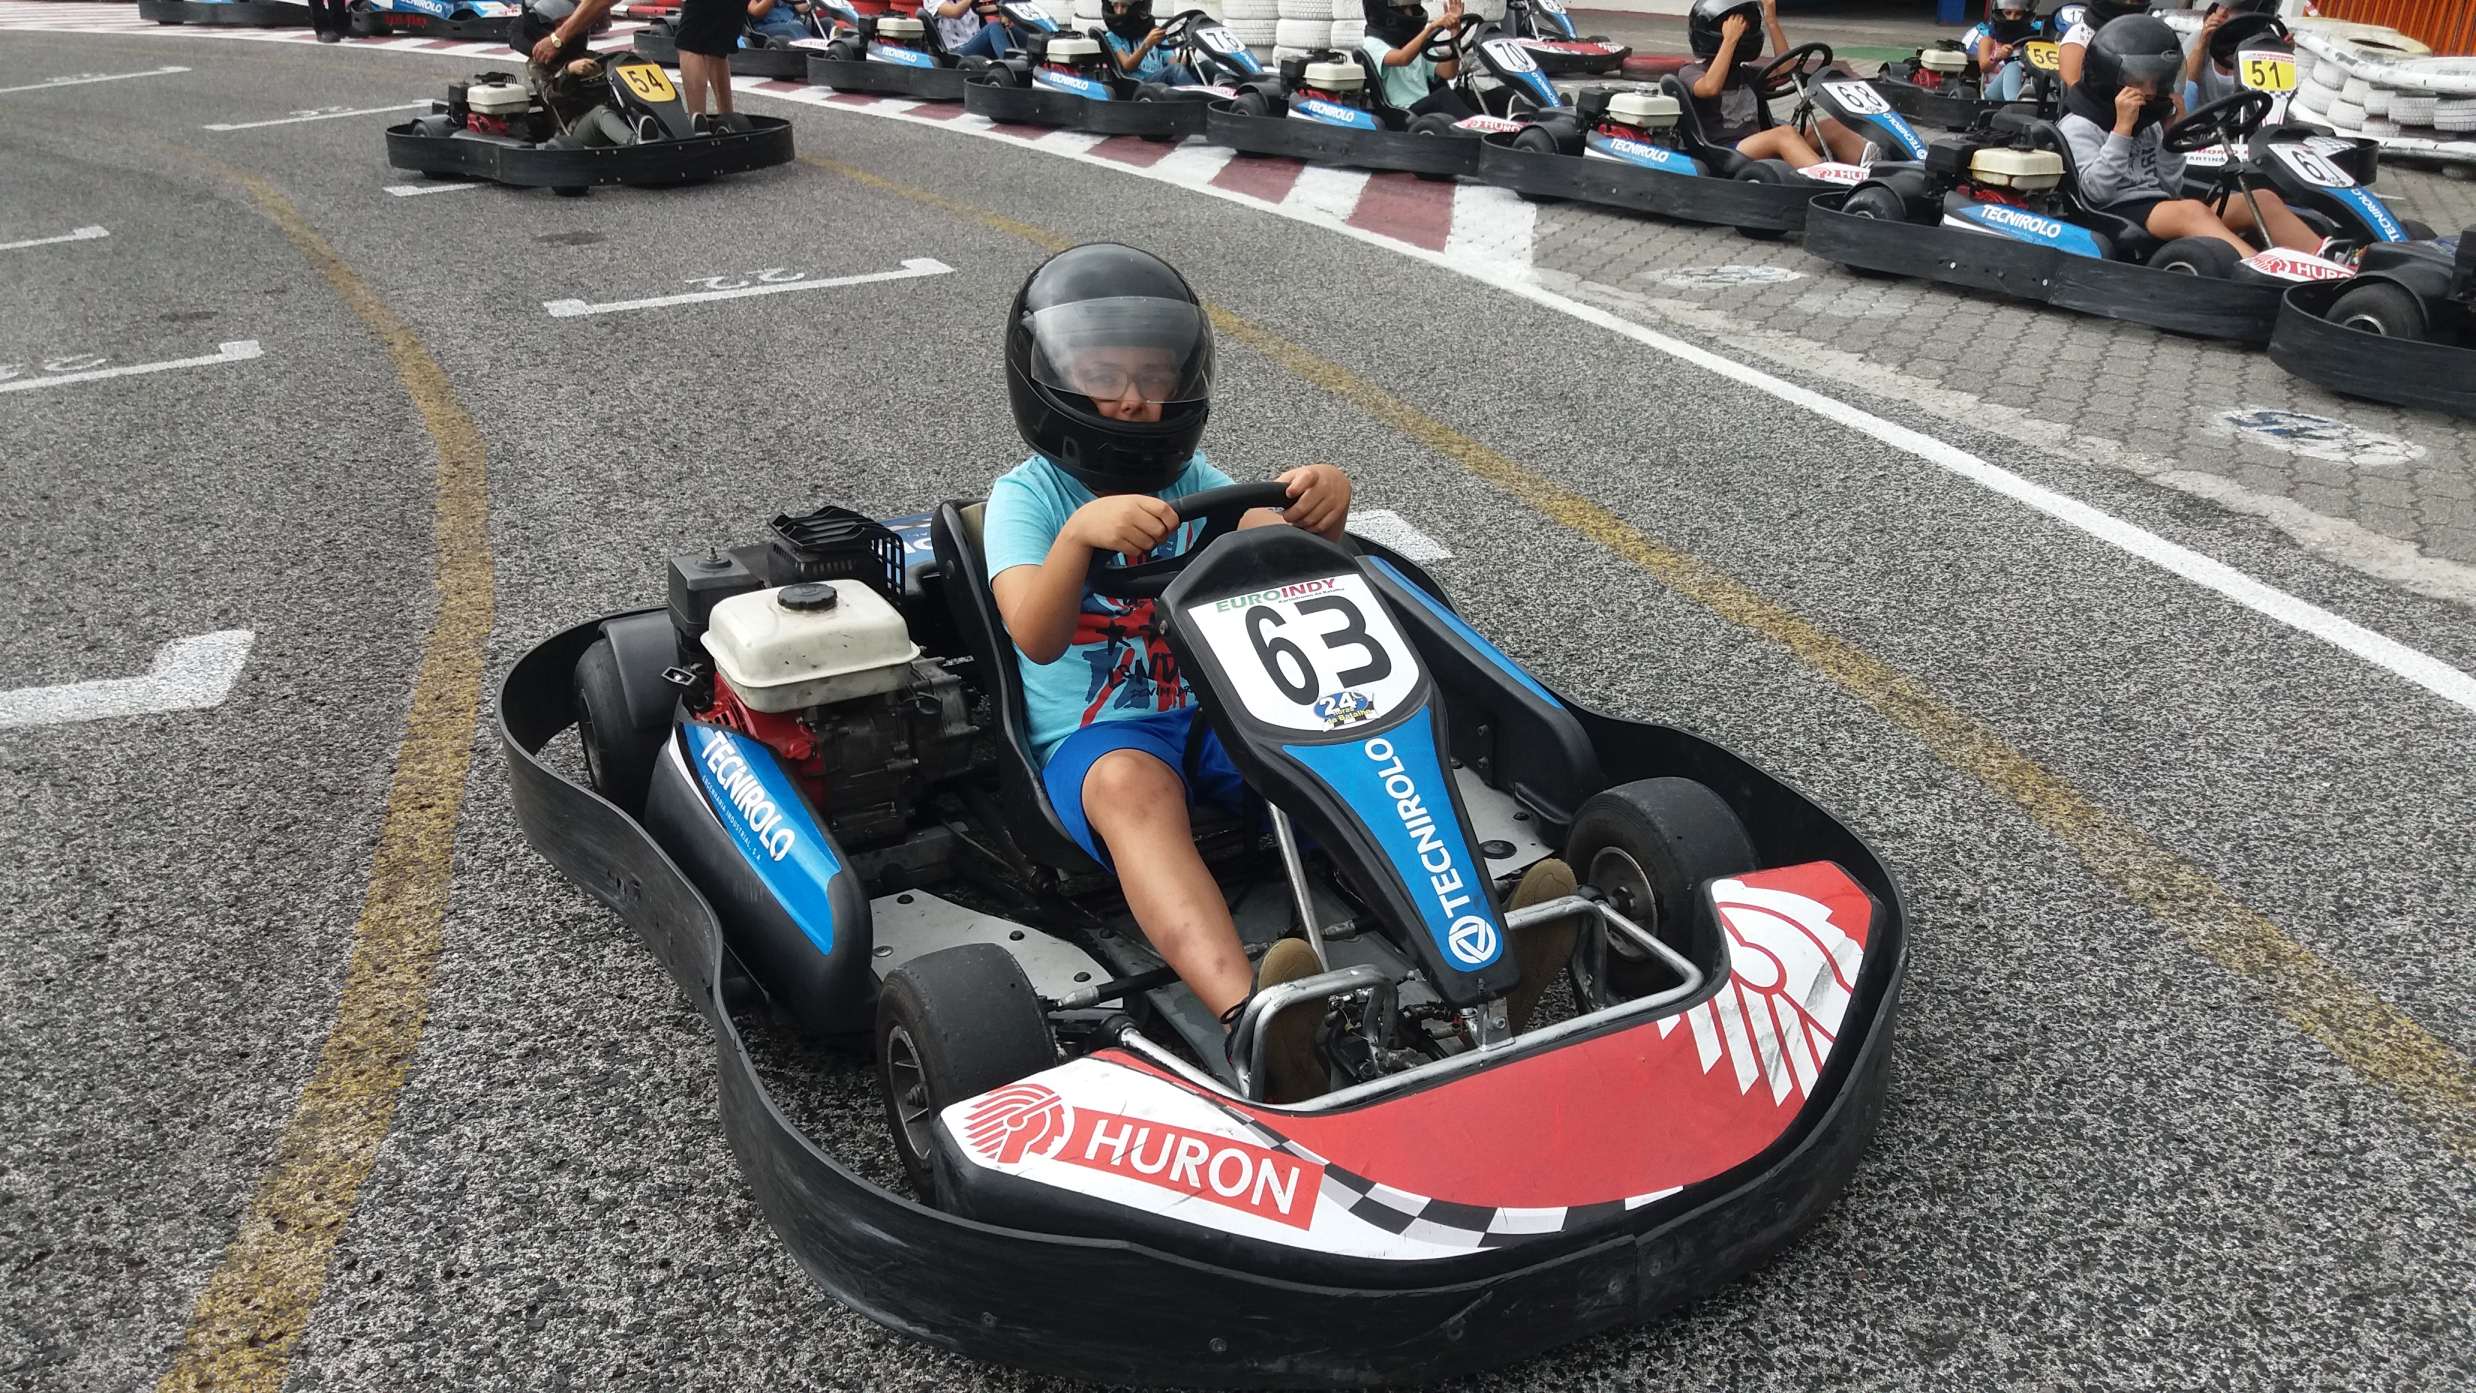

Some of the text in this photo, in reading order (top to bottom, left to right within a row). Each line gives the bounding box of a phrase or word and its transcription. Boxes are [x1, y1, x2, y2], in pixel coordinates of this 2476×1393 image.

[1206, 31, 1239, 49] 76
[1494, 41, 1529, 67] 70
[2033, 48, 2059, 65] 56
[627, 69, 665, 93] 54
[2252, 60, 2281, 88] 51
[1837, 84, 1883, 109] 68
[1308, 100, 1354, 122] TECNIROLO
[1610, 138, 1669, 163] TECNIROLO
[1981, 204, 2062, 238] TECNIROLO
[2351, 188, 2401, 243] TECNIROLO
[1216, 578, 1336, 613] EUROINDY
[1245, 595, 1392, 706] 63
[1319, 691, 1358, 717] 24
[701, 730, 796, 862] TECNIROLO
[1365, 738, 1470, 918] TECNIROLO
[1085, 1118, 1301, 1216] HURON
